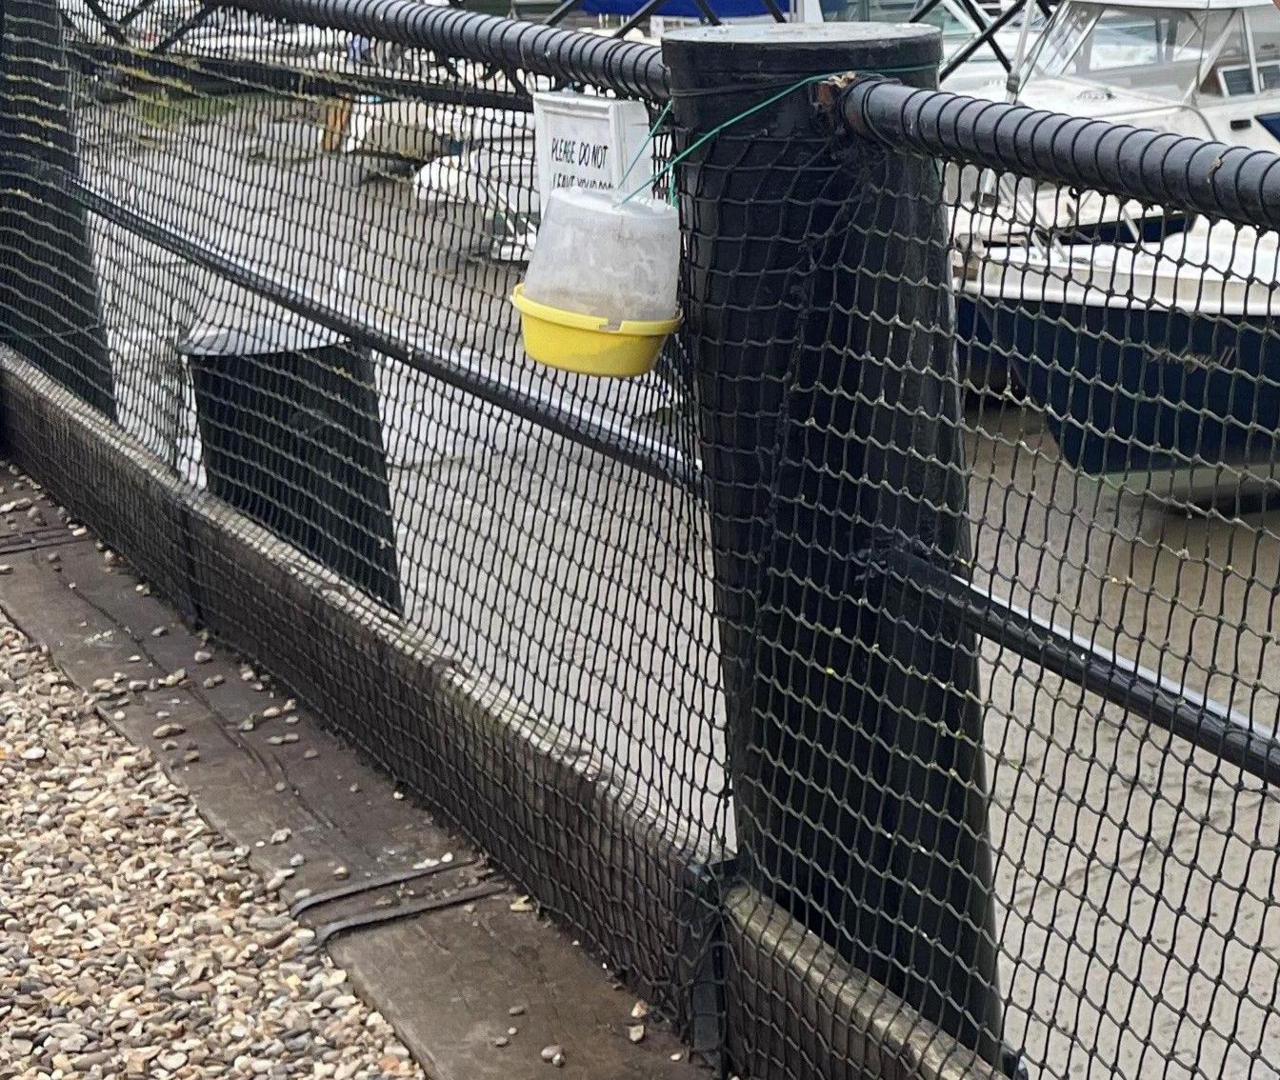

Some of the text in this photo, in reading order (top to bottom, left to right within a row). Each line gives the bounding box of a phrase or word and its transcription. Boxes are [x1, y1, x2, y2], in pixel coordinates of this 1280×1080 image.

[551, 137, 609, 169] PLEASE DO NOT
